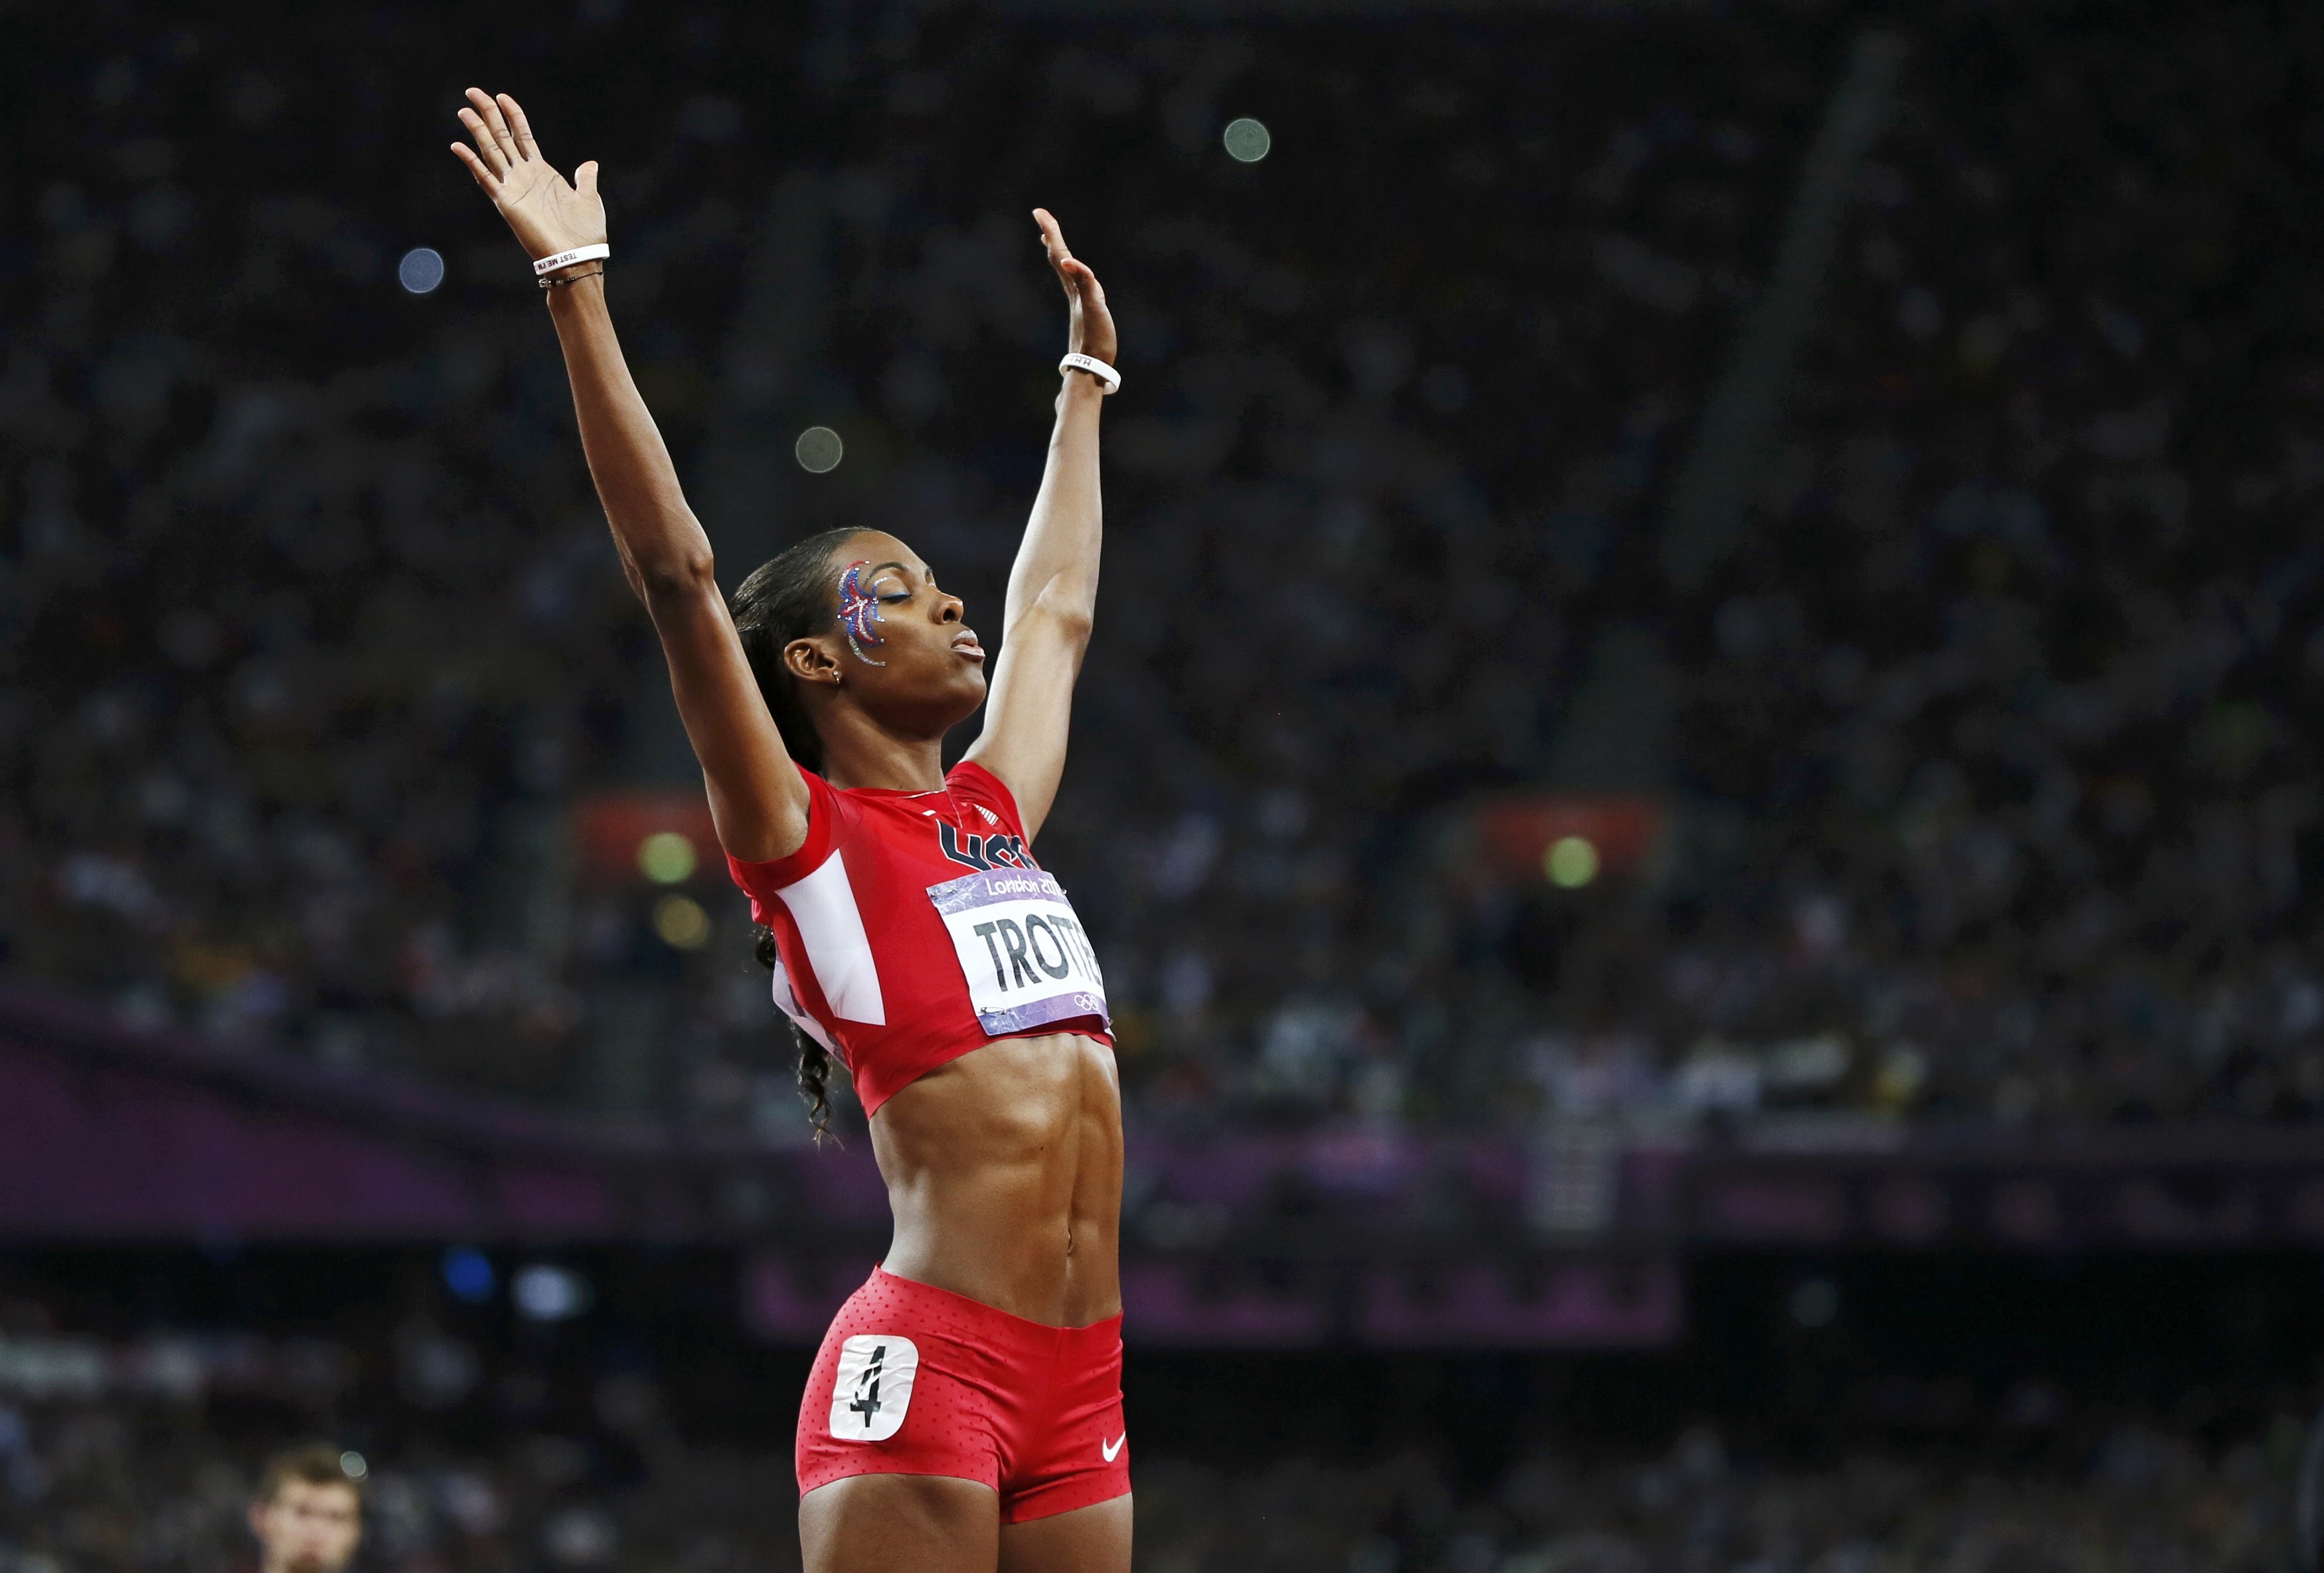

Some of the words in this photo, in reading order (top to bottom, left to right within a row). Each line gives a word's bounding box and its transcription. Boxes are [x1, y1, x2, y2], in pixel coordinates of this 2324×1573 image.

[547, 258, 558, 267] ME
[560, 253, 577, 263] TEST
[985, 874, 1040, 896] London
[850, 1346, 886, 1428] 4
